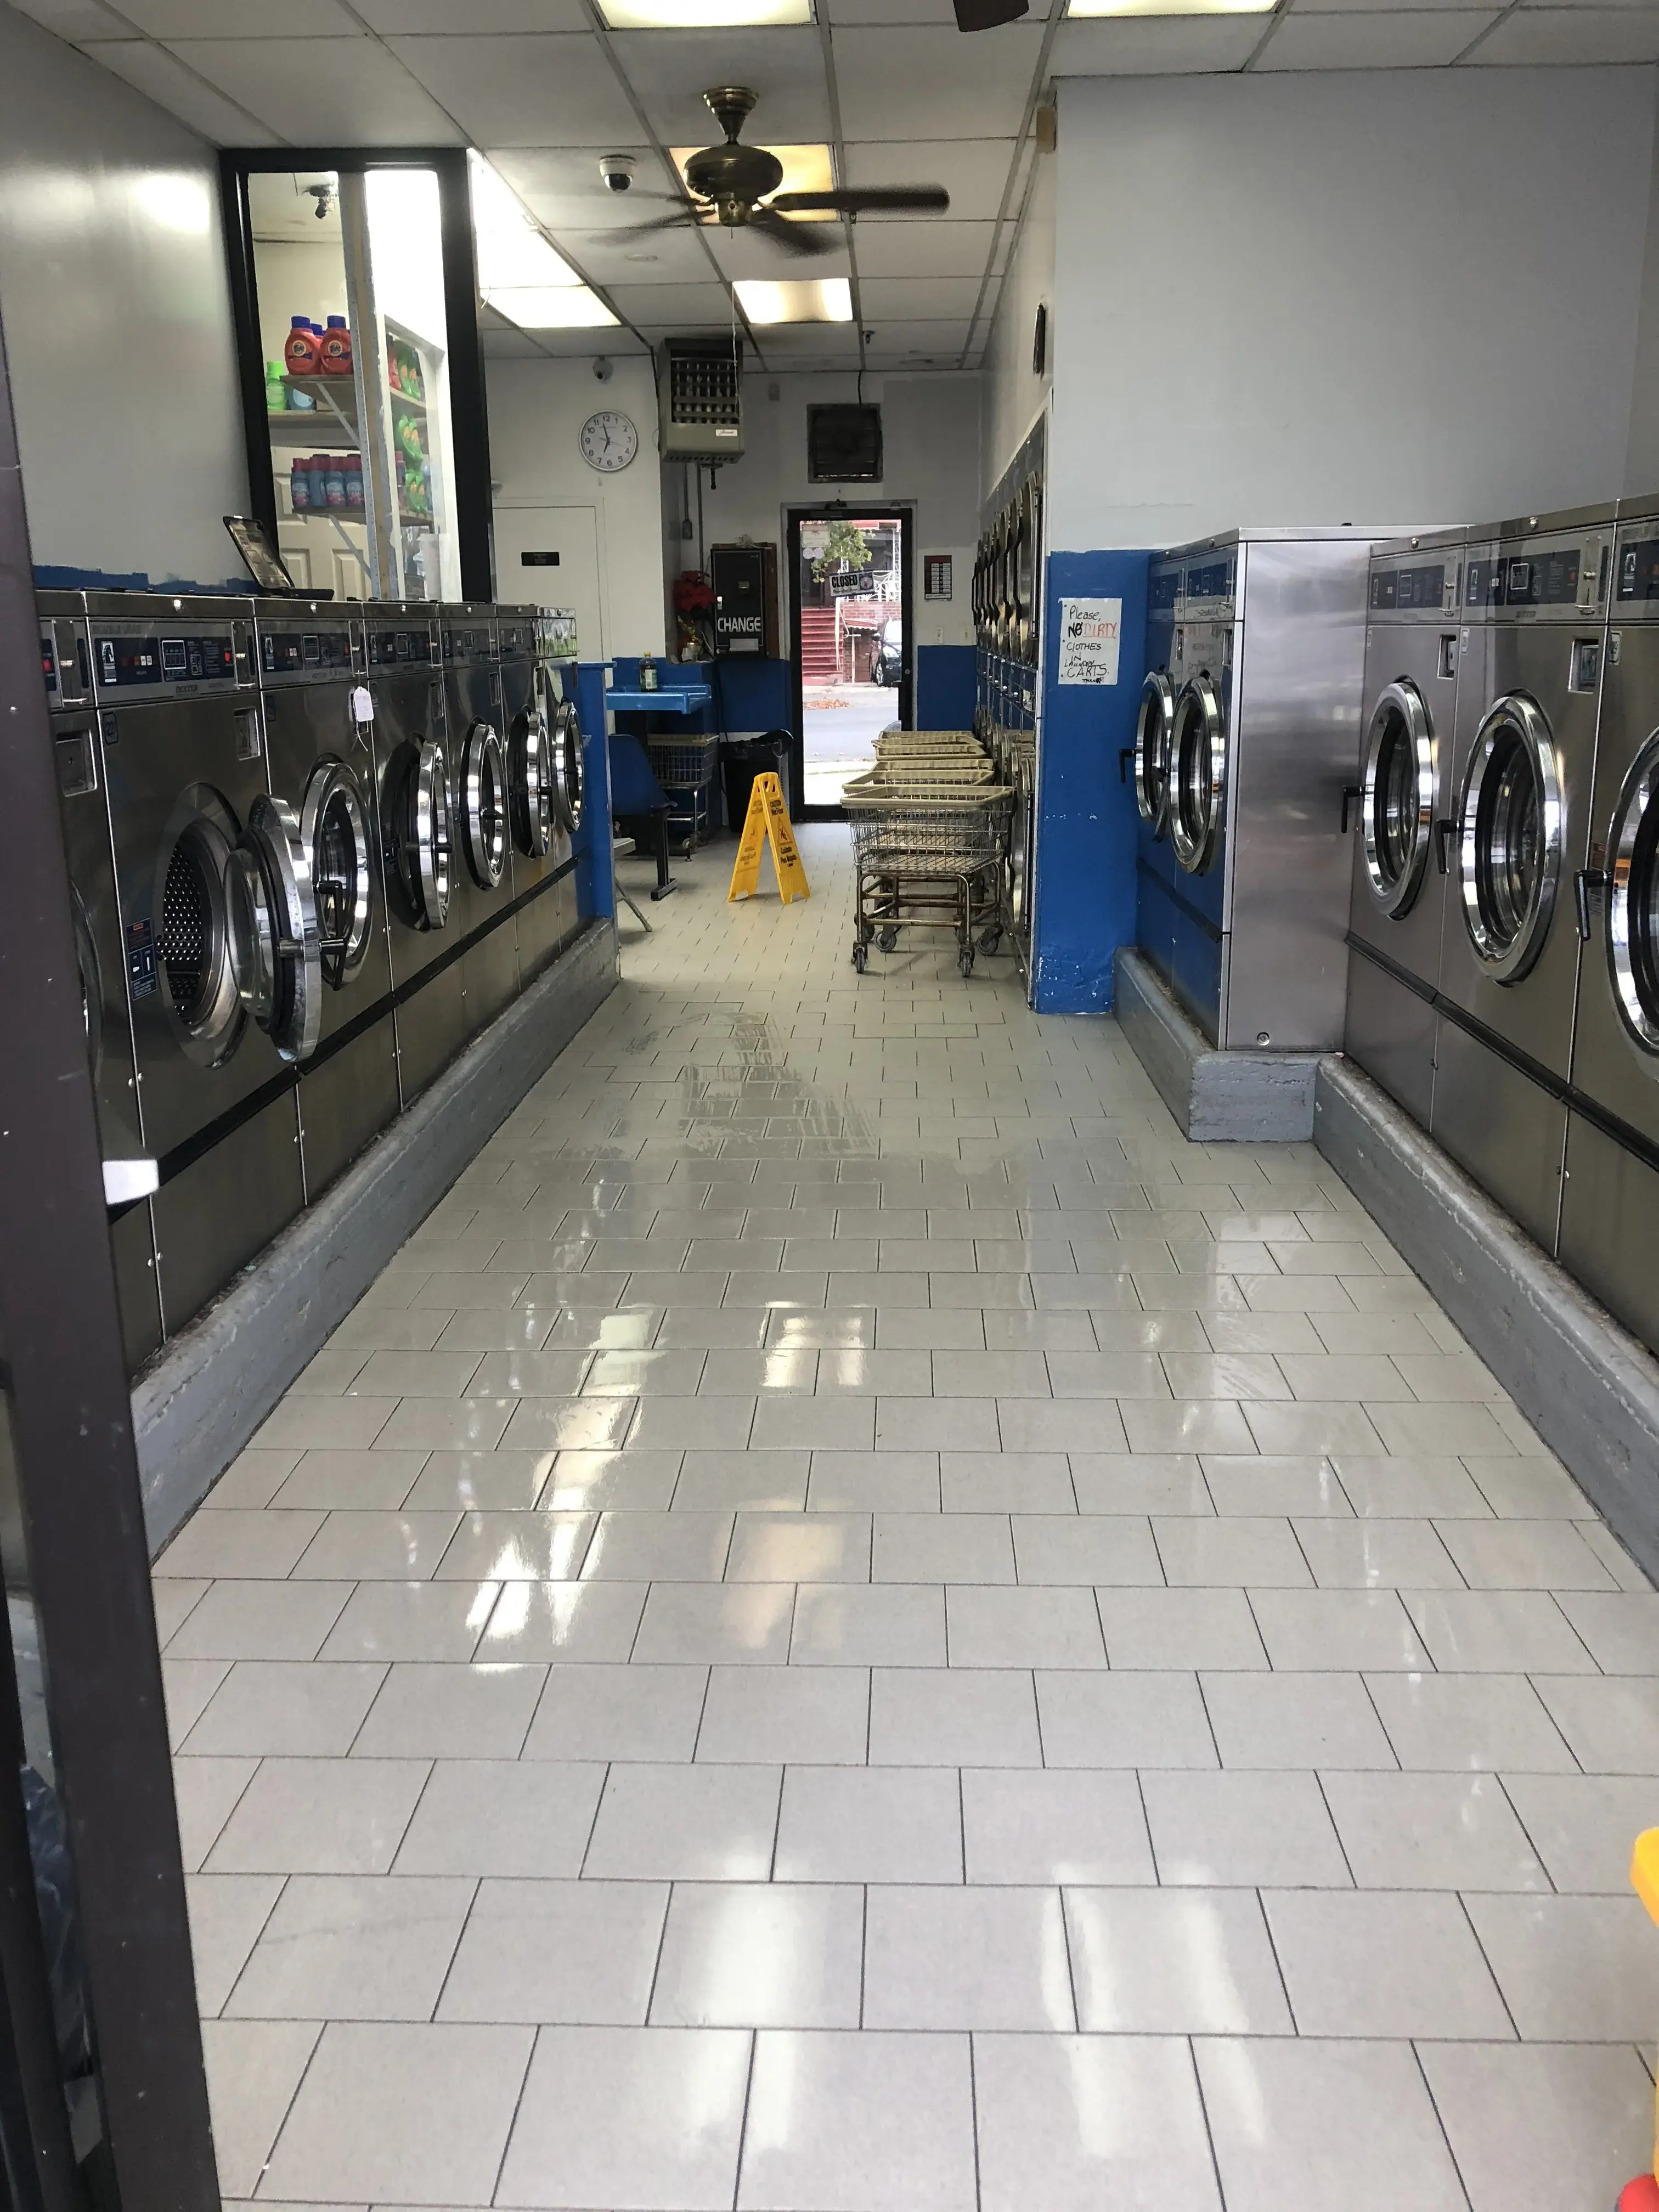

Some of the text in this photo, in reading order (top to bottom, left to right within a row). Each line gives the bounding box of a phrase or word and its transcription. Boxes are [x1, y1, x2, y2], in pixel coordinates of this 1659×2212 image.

[831, 574, 857, 588] CLOSED
[1069, 605, 1101, 622] Please,
[718, 617, 761, 633] CHANGE
[1068, 622, 1117, 638] NO DIRTY
[1071, 652, 1081, 661] IN
